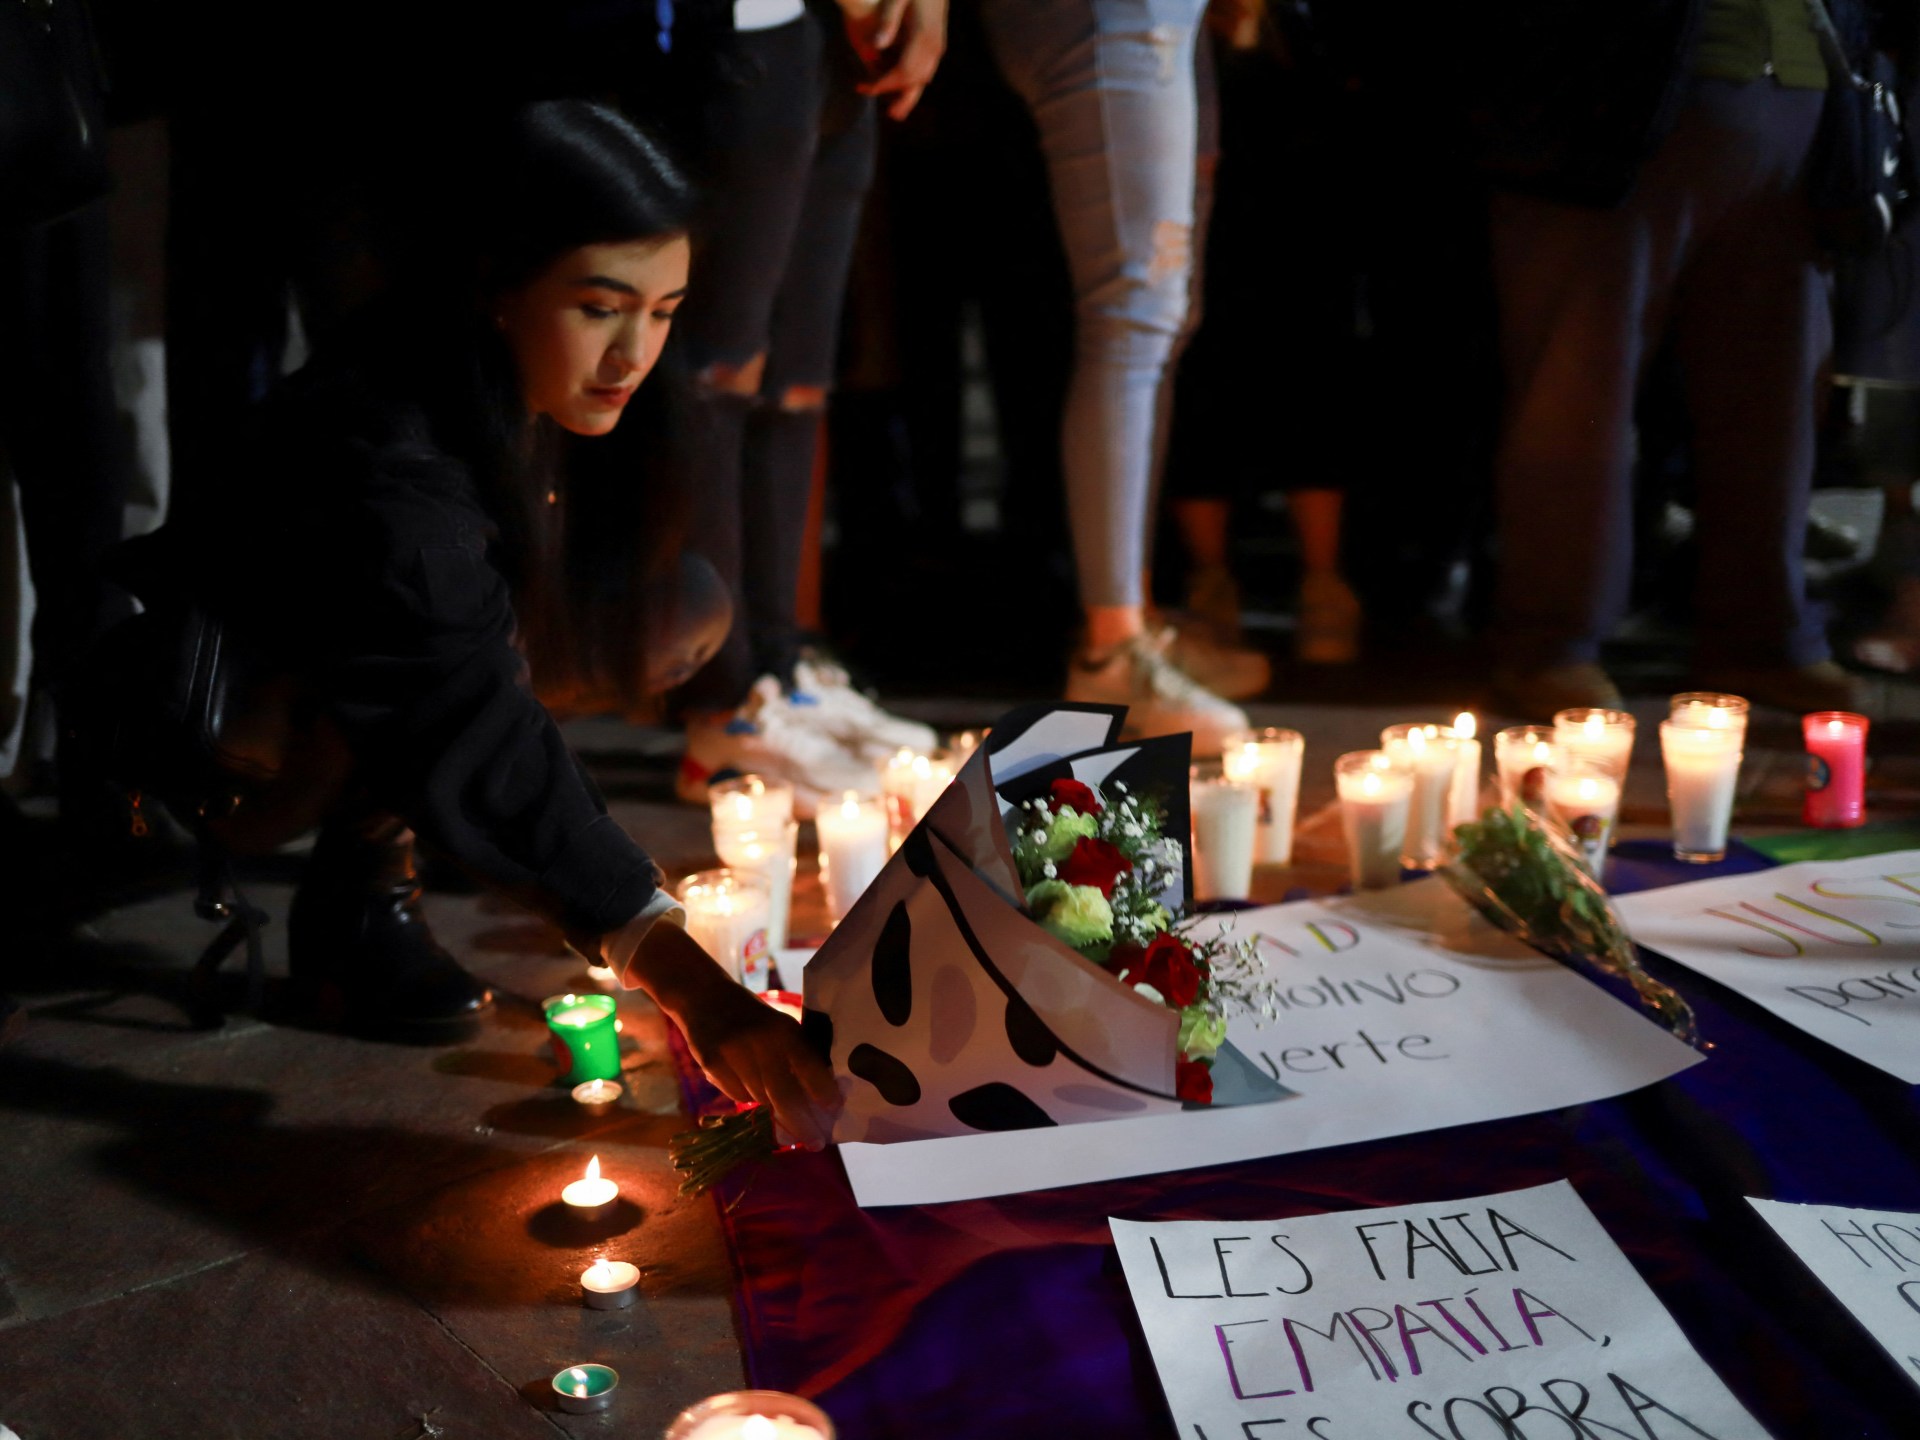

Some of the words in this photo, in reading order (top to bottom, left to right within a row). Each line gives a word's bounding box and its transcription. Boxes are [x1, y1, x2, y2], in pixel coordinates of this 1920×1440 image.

[1785, 966, 1920, 1026] par
[1149, 1234, 1313, 1299] LES
[1356, 1208, 1577, 1280] FALTA
[1820, 1219, 1920, 1272] HO
